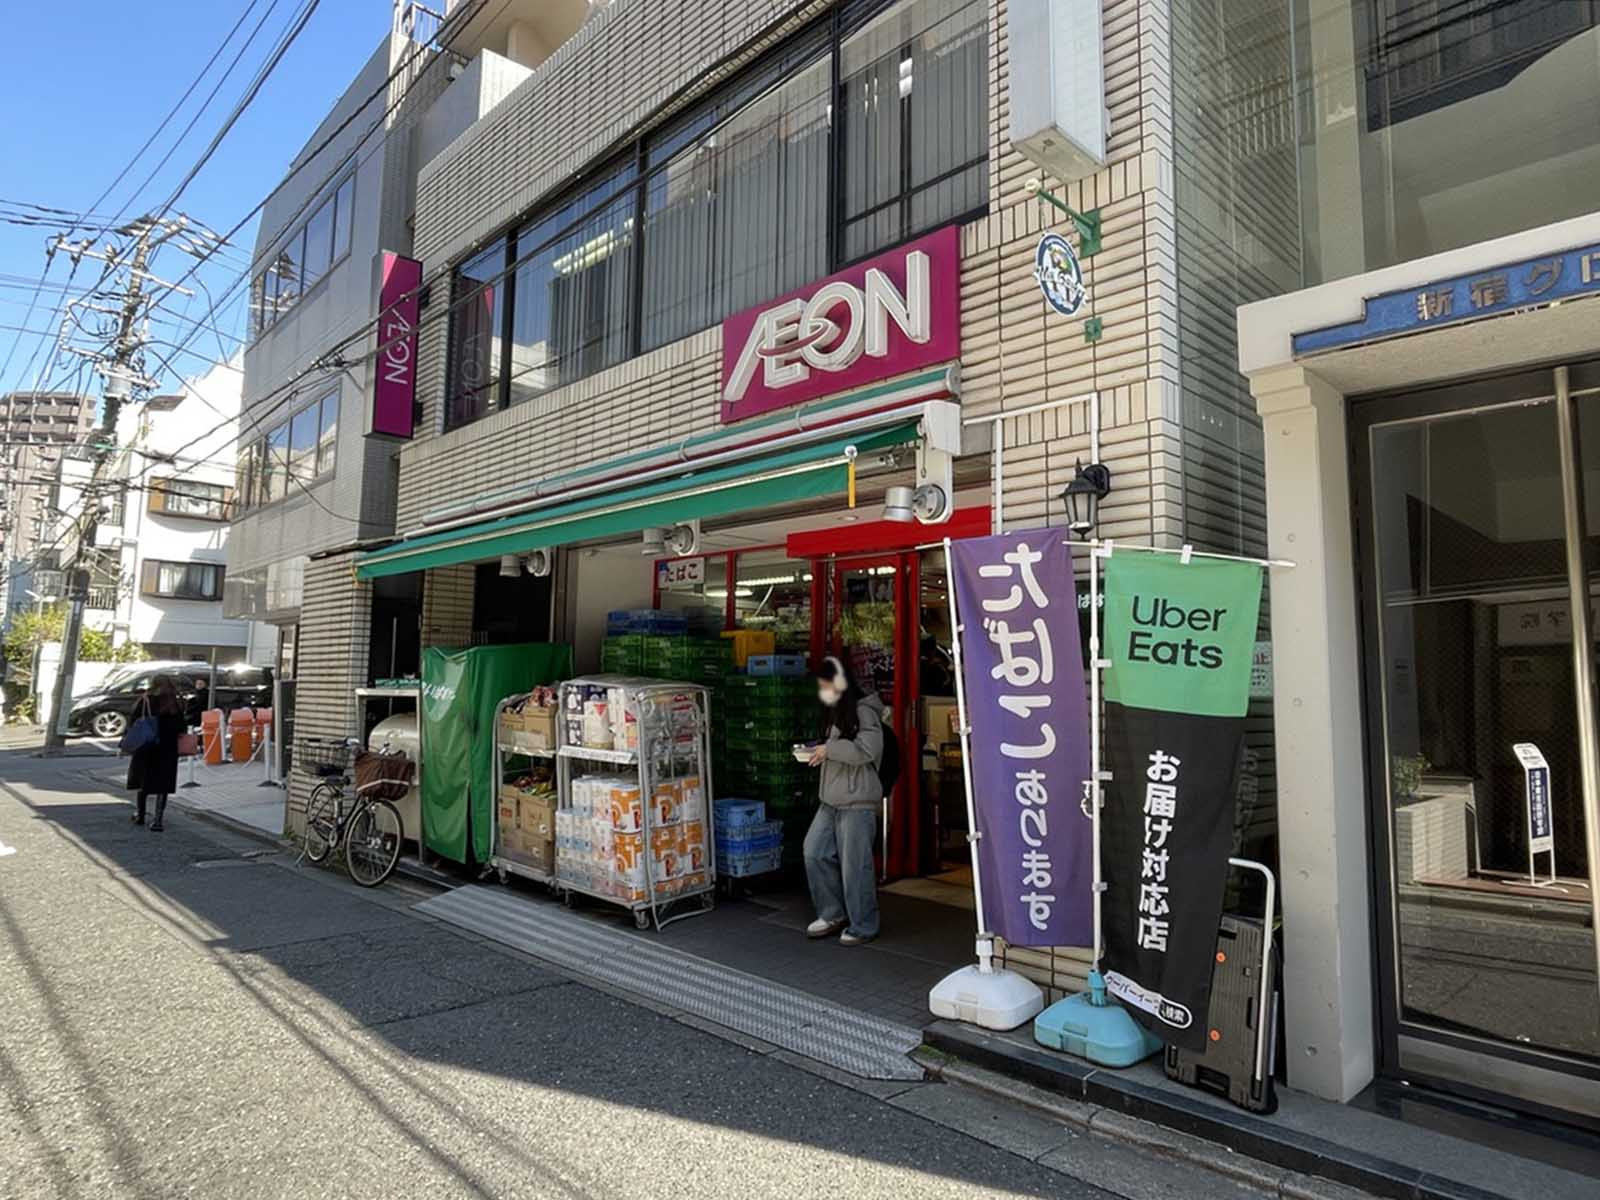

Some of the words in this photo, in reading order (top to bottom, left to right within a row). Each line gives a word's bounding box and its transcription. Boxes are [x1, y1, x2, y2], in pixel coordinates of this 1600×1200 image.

[1131, 595, 1228, 632] Uber
[1127, 631, 1224, 669] Eats
[1136, 750, 1182, 953] お届け対応店
